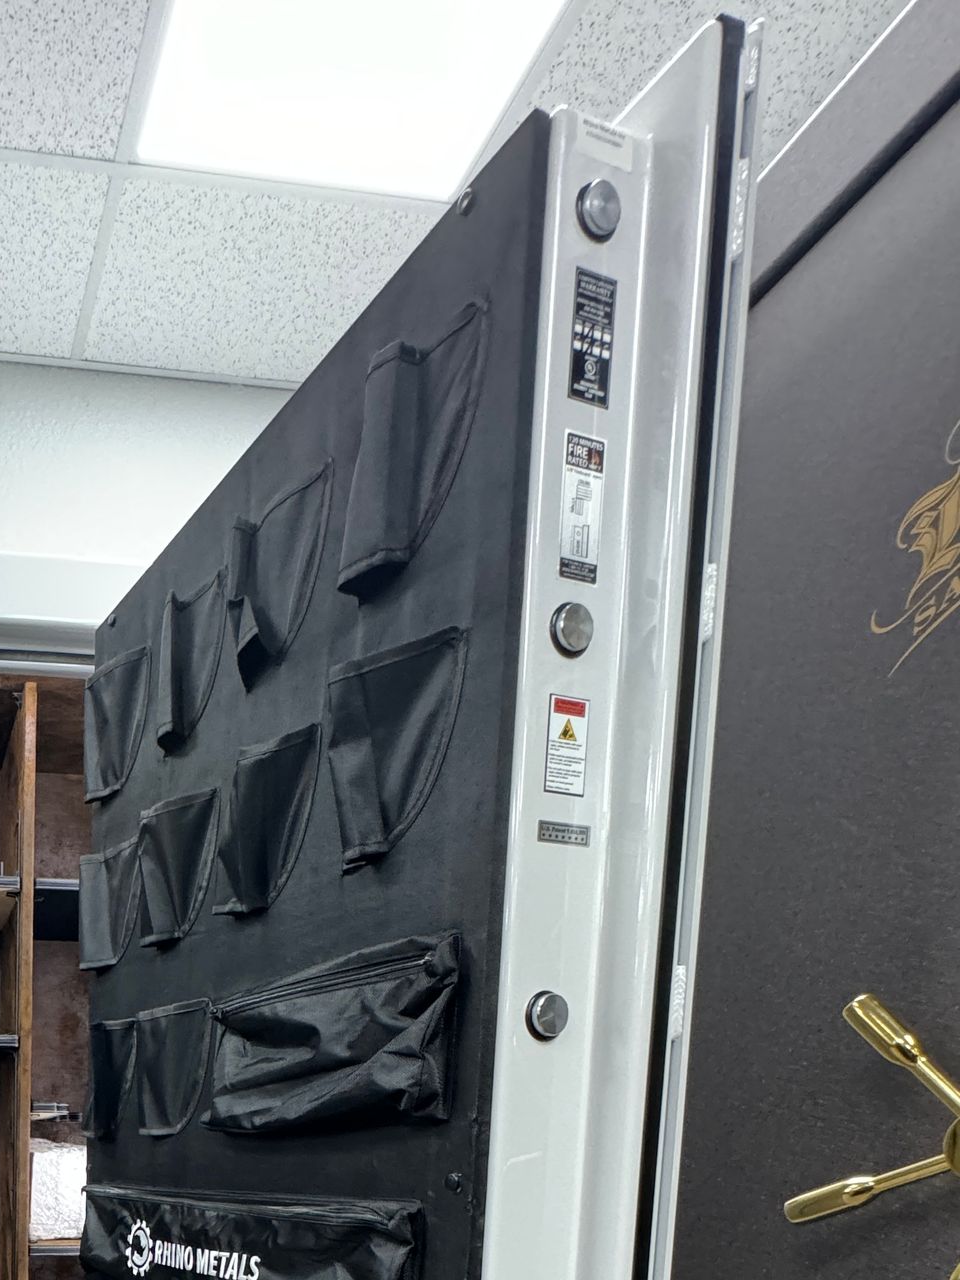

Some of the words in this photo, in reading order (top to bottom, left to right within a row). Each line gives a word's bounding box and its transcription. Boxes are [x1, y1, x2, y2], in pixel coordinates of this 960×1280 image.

[568, 443, 589, 459] FIRE
[579, 438, 604, 452] MINUTES
[568, 455, 589, 468] RATED
[153, 1239, 194, 1271] RHINO
